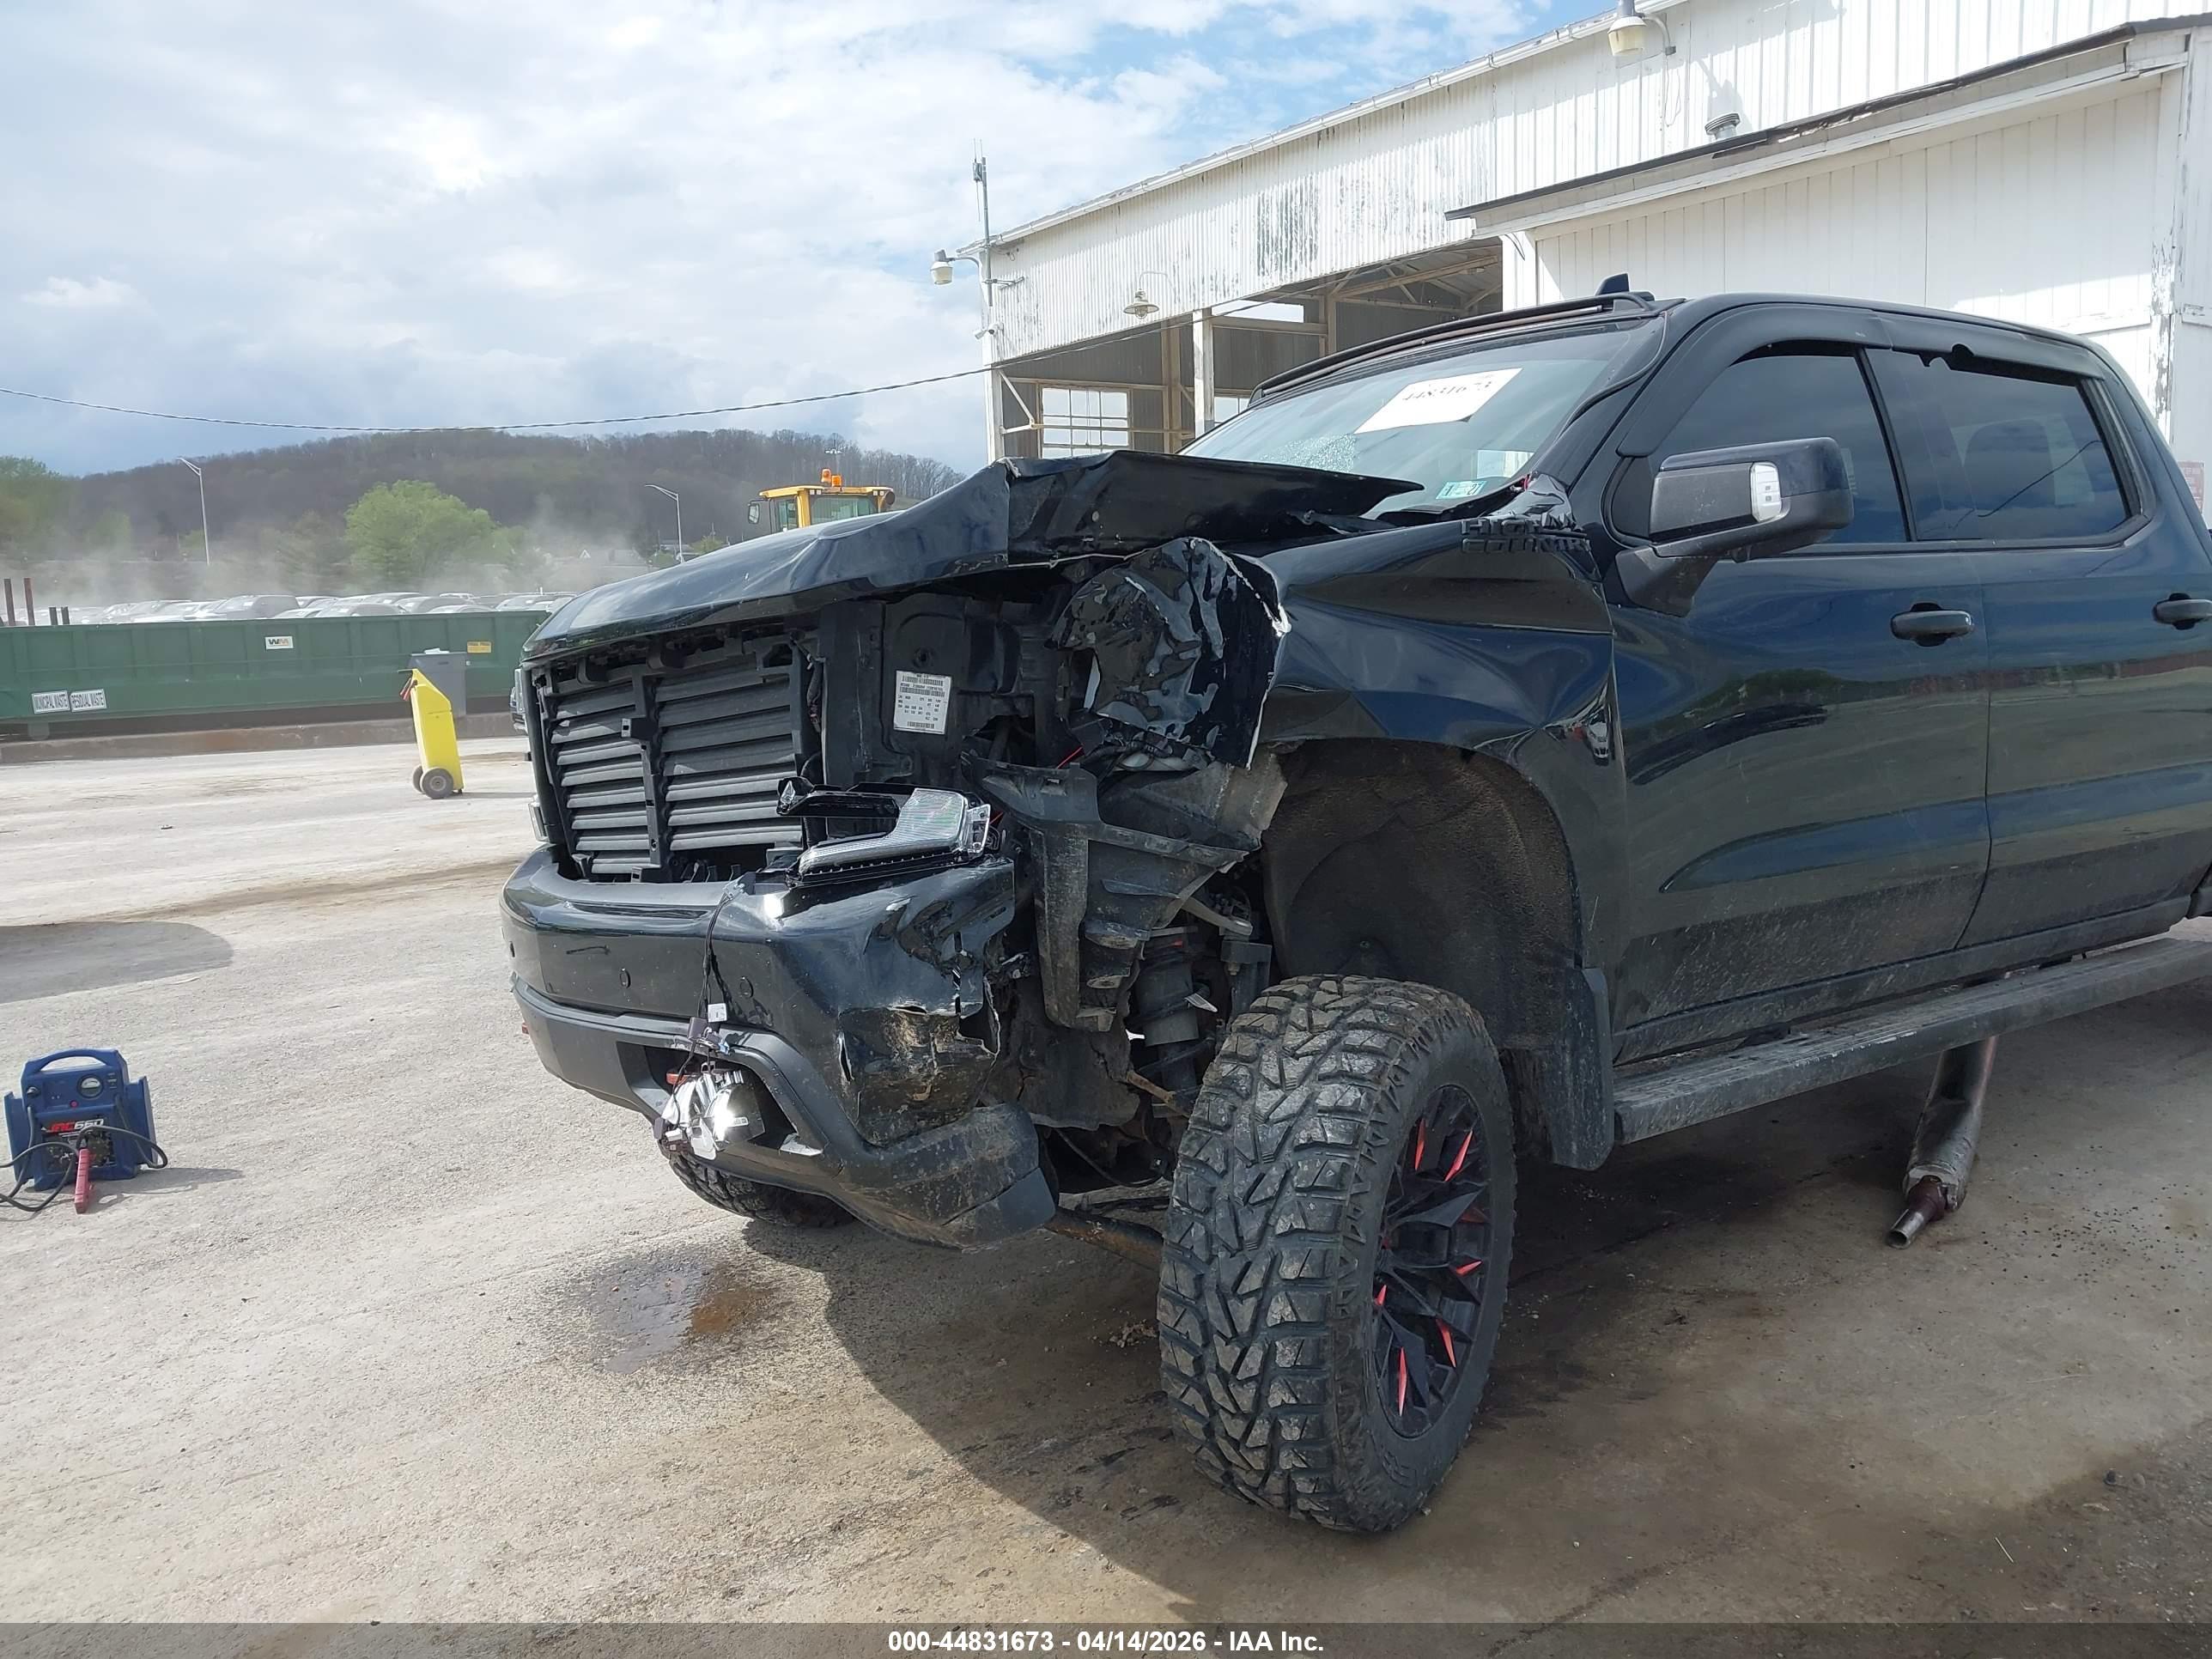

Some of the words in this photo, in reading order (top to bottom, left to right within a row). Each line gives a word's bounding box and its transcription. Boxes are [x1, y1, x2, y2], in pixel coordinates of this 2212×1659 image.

[1467, 483, 1483, 495] 27
[54, 694, 69, 708] WASTE
[70, 694, 92, 708] RESIDUAL
[91, 692, 105, 707] WASTE
